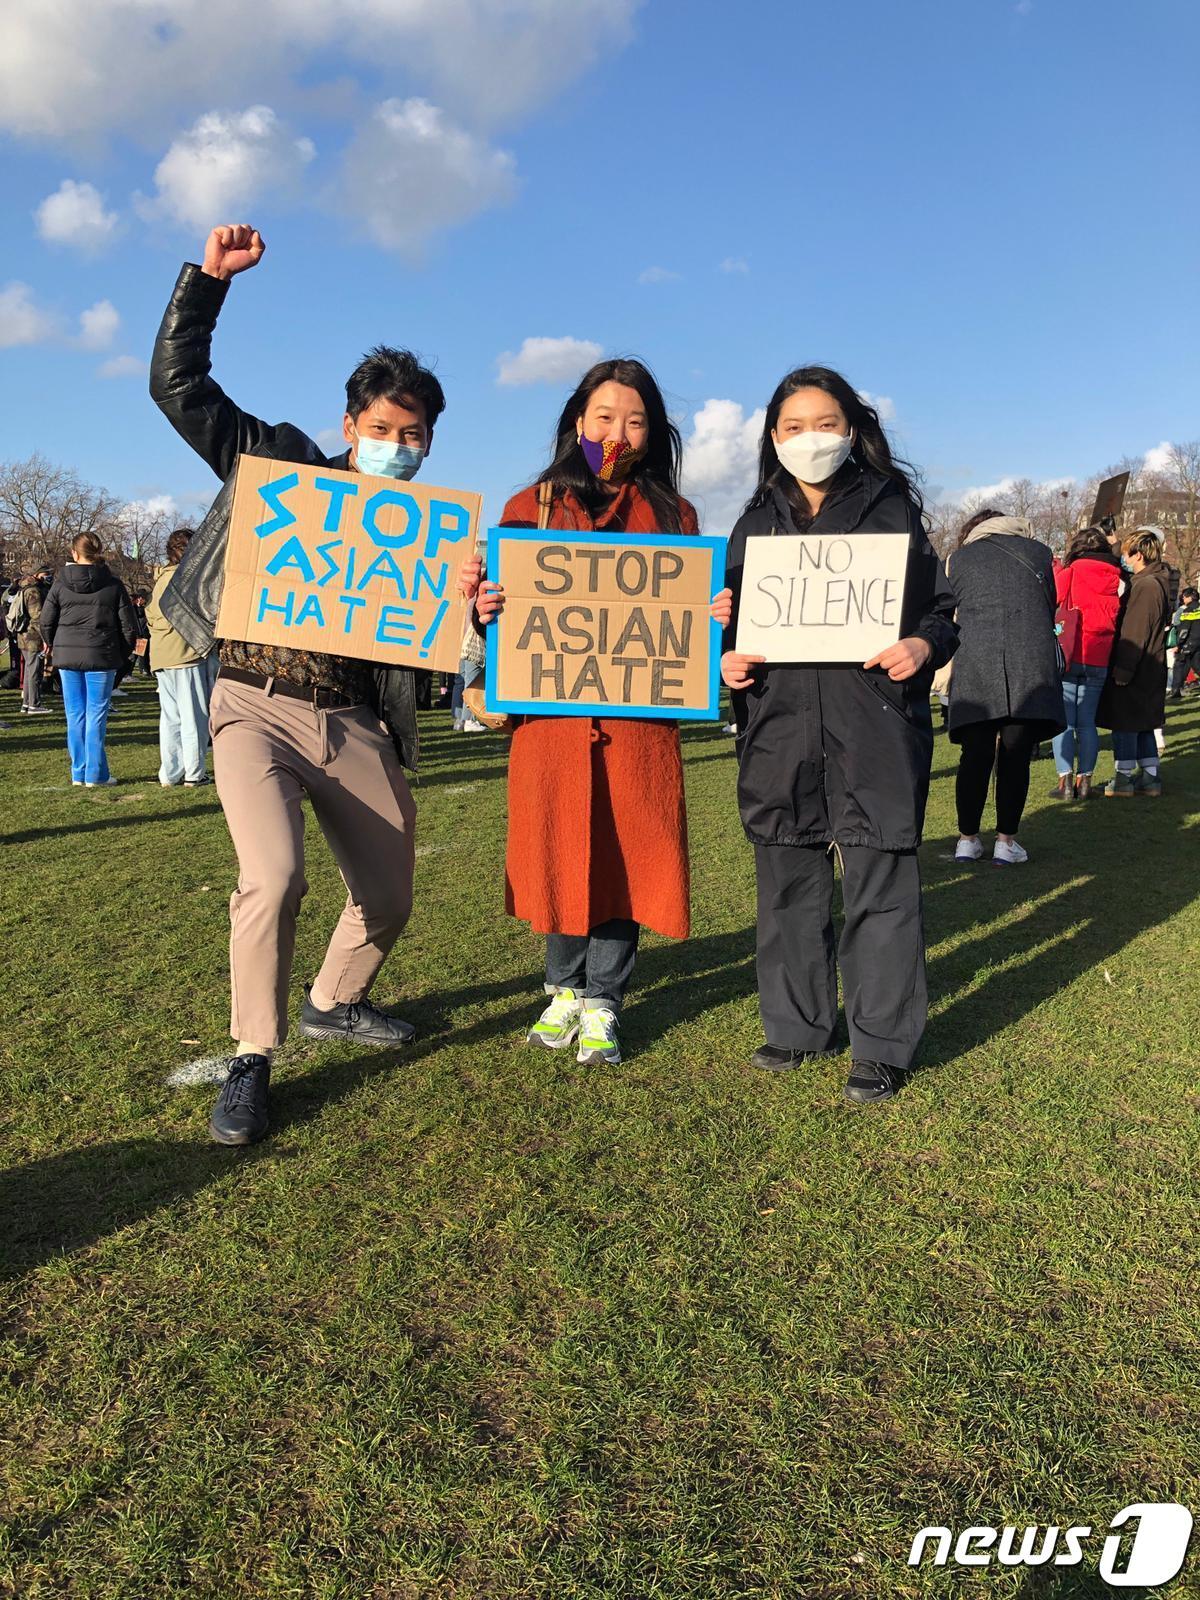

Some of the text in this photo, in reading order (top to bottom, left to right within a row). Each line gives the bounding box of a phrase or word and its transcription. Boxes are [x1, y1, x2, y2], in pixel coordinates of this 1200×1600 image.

[254, 473, 470, 558] STOP
[265, 535, 448, 601] ASIAN
[534, 545, 684, 598] STOP
[799, 539, 853, 574] NO
[257, 587, 449, 658] HATE!
[750, 575, 898, 628] SILENCE
[516, 605, 693, 658] ASIAN
[531, 653, 686, 706] HATE
